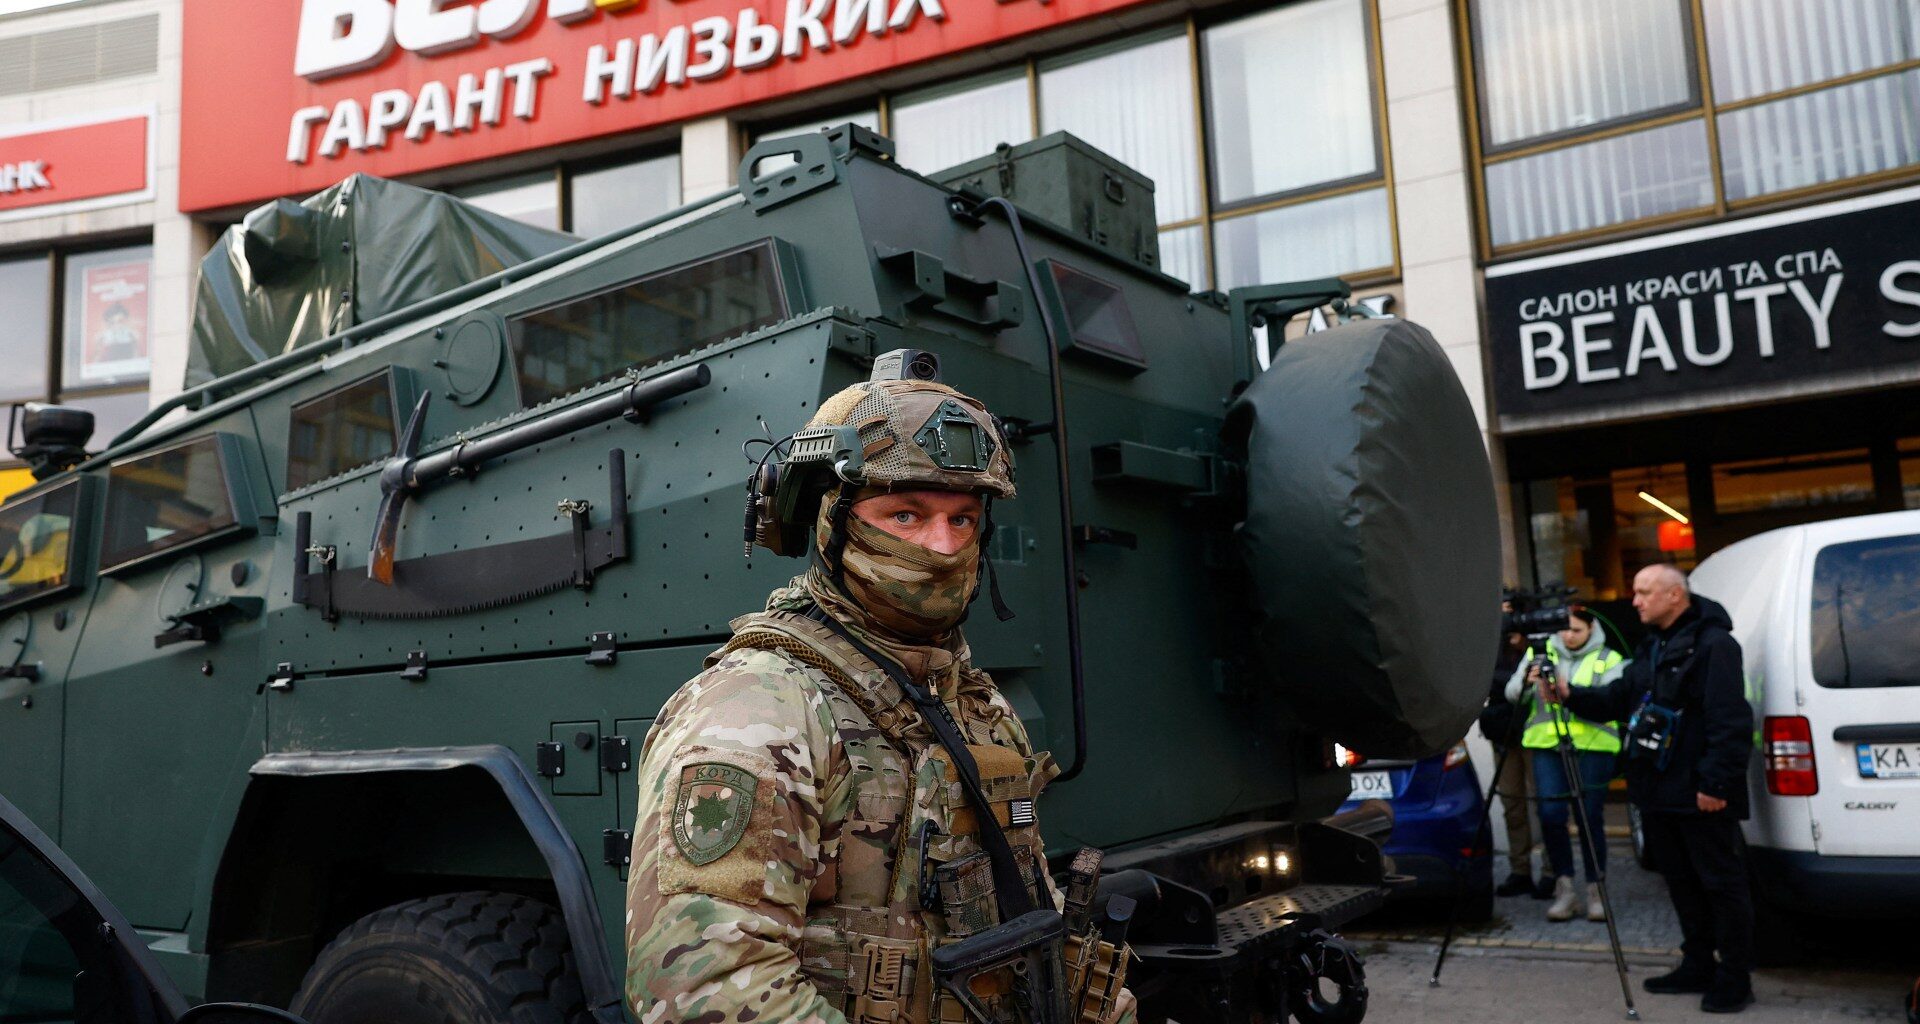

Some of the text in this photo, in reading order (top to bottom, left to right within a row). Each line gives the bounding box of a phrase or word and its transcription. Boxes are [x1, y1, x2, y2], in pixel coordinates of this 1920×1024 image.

[286, 57, 553, 165] ГАРАНТ
[1519, 247, 1843, 321] САЛОН КРАСИ ТА СПА
[1519, 272, 1844, 390] BEAUTY
[694, 766, 743, 783] КОРД
[1844, 801, 1899, 810] CADDY
